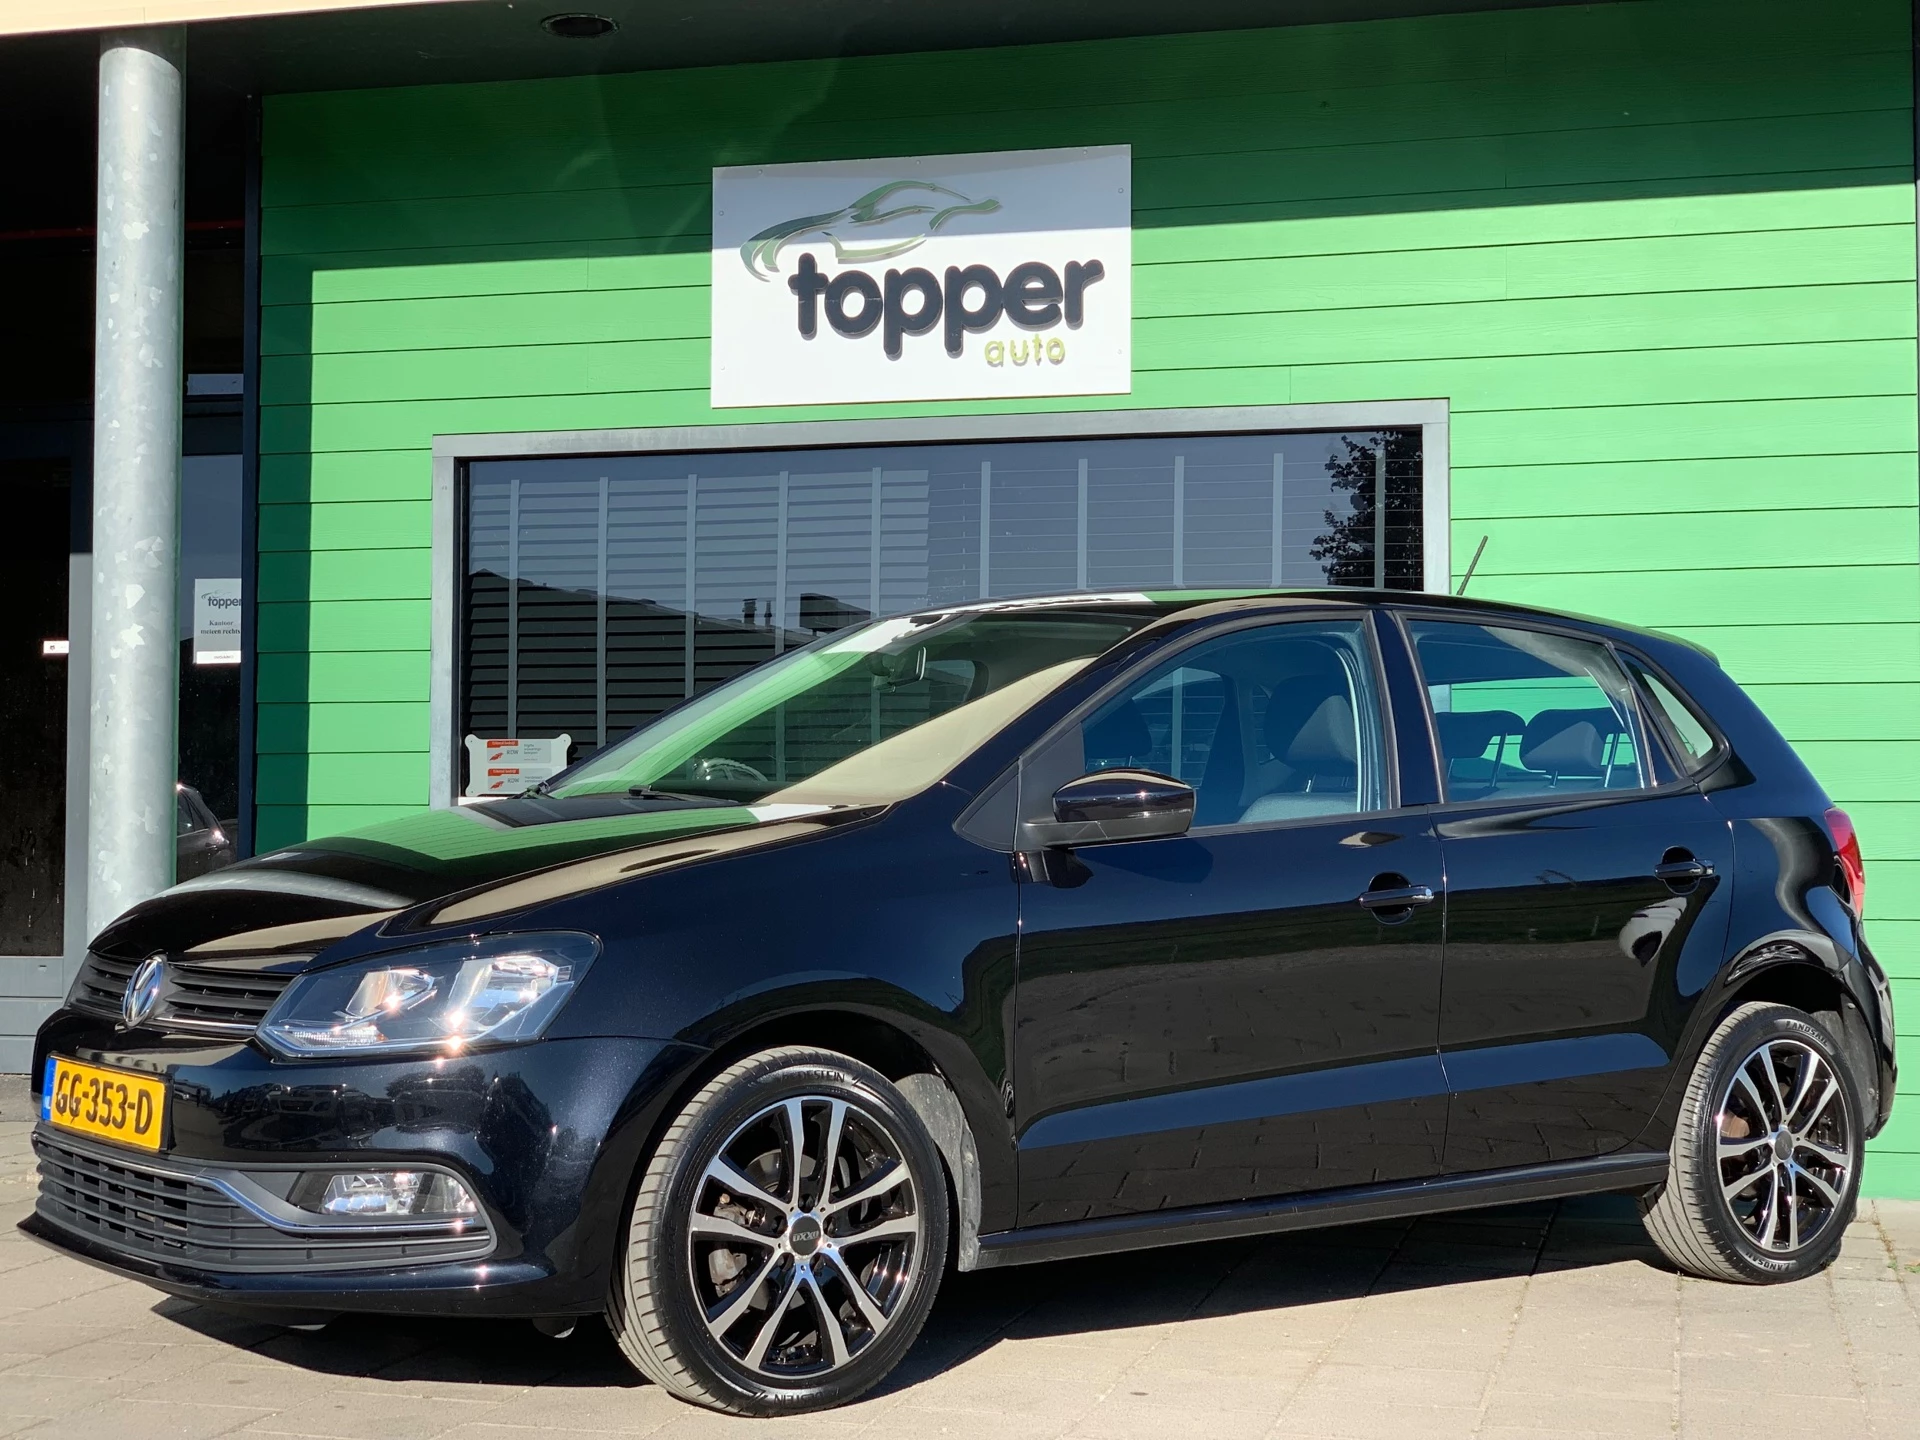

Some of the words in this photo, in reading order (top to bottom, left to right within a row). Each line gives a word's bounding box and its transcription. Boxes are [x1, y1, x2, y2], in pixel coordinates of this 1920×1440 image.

[788, 252, 1105, 358] topper
[984, 334, 1066, 366] auto
[55, 1070, 153, 1136] GG-353-D
